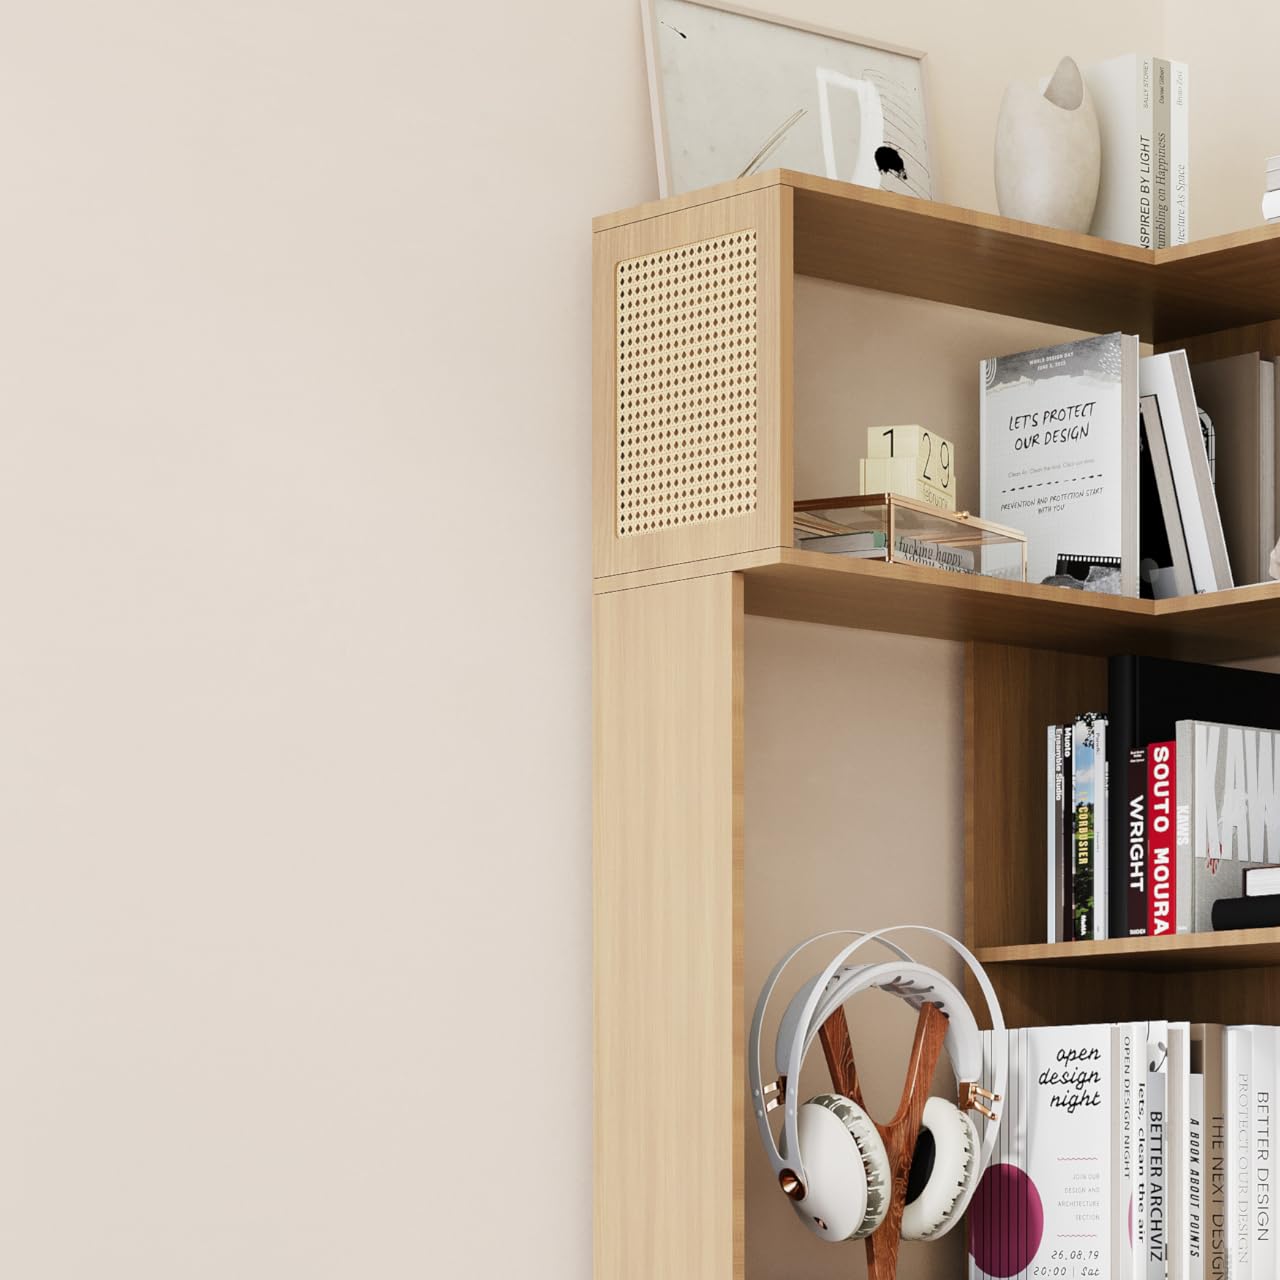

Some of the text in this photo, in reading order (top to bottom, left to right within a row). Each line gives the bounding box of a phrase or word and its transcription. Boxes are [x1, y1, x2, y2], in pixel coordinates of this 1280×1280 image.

[1139, 134, 1150, 193] BY LIGHT
[1156, 133, 1168, 185] Happiness
[1042, 401, 1097, 426] PROTECT
[882, 428, 894, 458] 1
[1014, 421, 1090, 451] OUR DESIGN
[1000, 487, 1104, 512] PREVENTION AND PROTECTION START
[1053, 504, 1065, 513] YOU
[936, 542, 963, 567] happy
[1078, 806, 1089, 865] CORBUSIER
[1129, 794, 1144, 892] WRIGHT
[1154, 746, 1169, 936] SOUTO MOURA
[1177, 804, 1192, 847] KAWS
[1056, 1048, 1101, 1067] open
[1038, 1066, 1101, 1090] design
[1050, 1089, 1101, 1114] night
[1123, 1036, 1131, 1180] OPEN DESIGN NIGHT
[1212, 1116, 1225, 1150] THE
[1138, 1082, 1146, 1244] lets, clean the air
[1212, 1157, 1225, 1204] NEXT
[1239, 1073, 1249, 1265] PROTECT OUR DESIGN
[1257, 1091, 1269, 1241] BETTER DESIGN
[1057, 1200, 1100, 1208] ARCHITECTURE
[1150, 1111, 1163, 1262] BETTER ARCHVIZ
[1190, 1130, 1200, 1258] BOOK ABOUT POINTS
[1033, 1266, 1100, 1277] 20:00 Sat
[1051, 1249, 1099, 1261] 26.08.19
